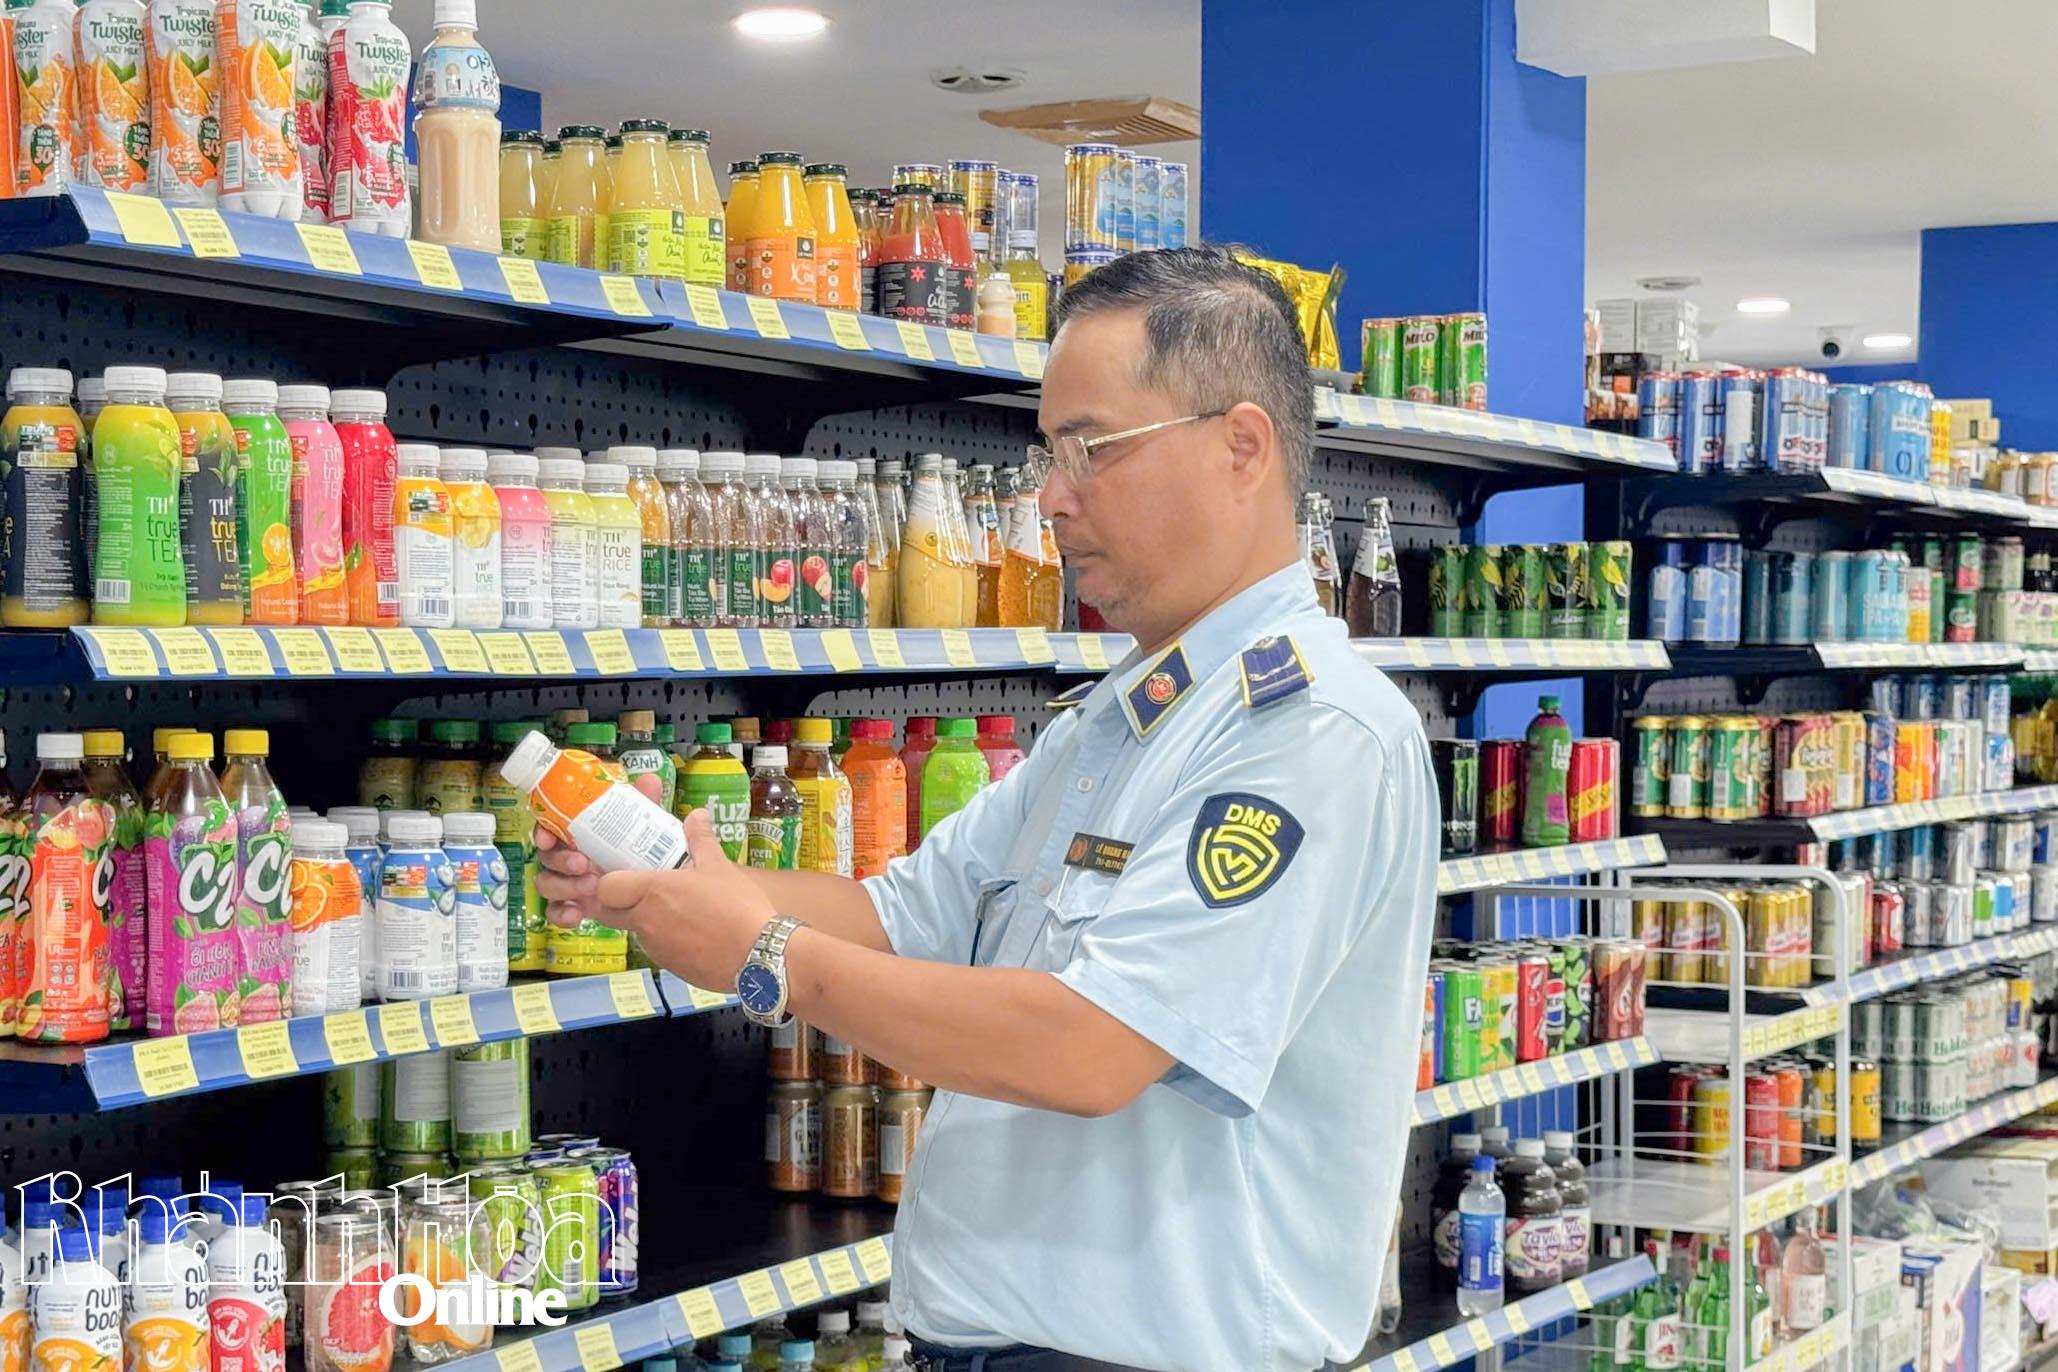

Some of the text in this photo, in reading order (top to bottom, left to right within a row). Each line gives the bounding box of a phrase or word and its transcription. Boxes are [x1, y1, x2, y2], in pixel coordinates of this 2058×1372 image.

[89, 21, 144, 45] Twiste
[159, 15, 215, 37] Twiste
[1405, 332, 1435, 346] MILO
[1463, 330, 1485, 342] MIL
[603, 544, 632, 559] true
[603, 558, 632, 572] RICE
[621, 755, 659, 769] XANH
[706, 794, 749, 823] fuz
[1224, 803, 1281, 836] DMS
[750, 848, 772, 858] reen
[179, 851, 235, 926] C2
